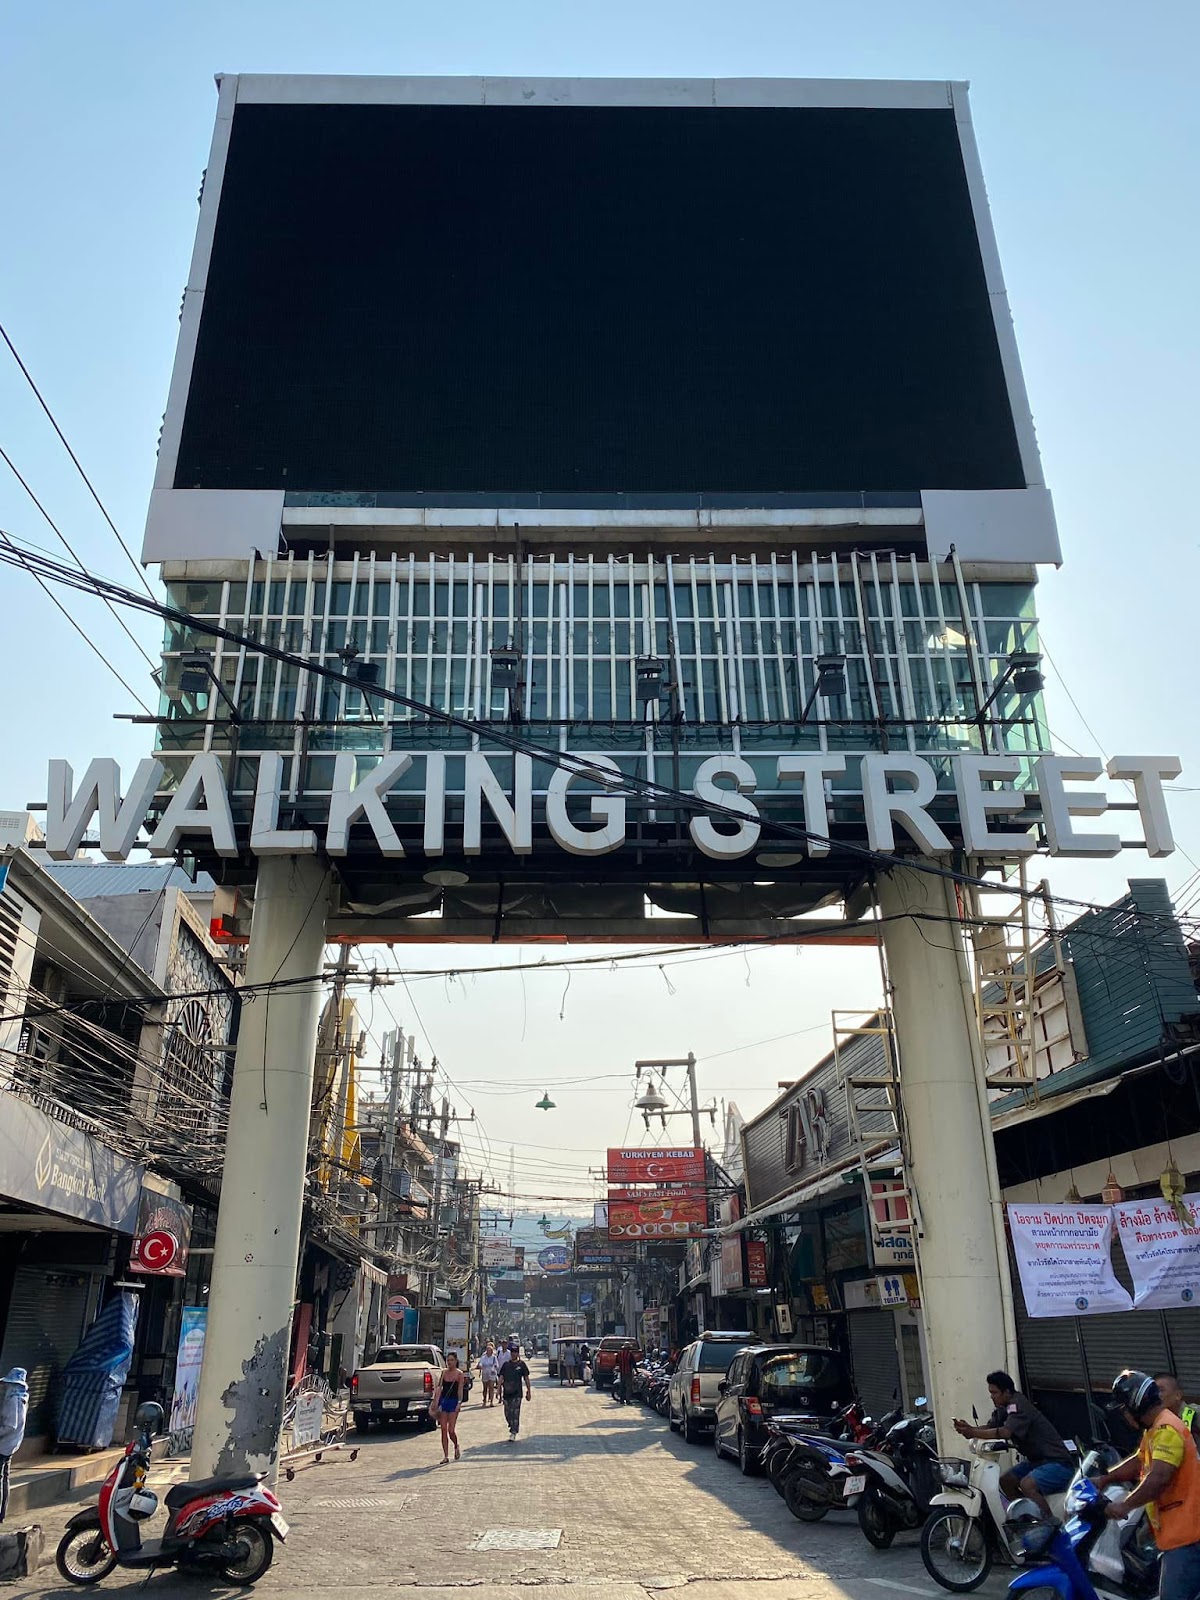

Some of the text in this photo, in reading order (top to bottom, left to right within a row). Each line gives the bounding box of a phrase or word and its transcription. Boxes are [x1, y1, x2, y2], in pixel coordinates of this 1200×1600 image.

[47, 754, 1182, 860] WALKING STREET
[51, 1164, 106, 1203] Bangkok Bank
[626, 1190, 648, 1198] SAM'S
[649, 1190, 665, 1198] FAST
[1015, 1211, 1109, 1228] ไอจาม ปิดปาก ปิดจมูก
[1119, 1209, 1151, 1228] ล้างมือ
[1135, 1230, 1179, 1243] คือทางรอด
